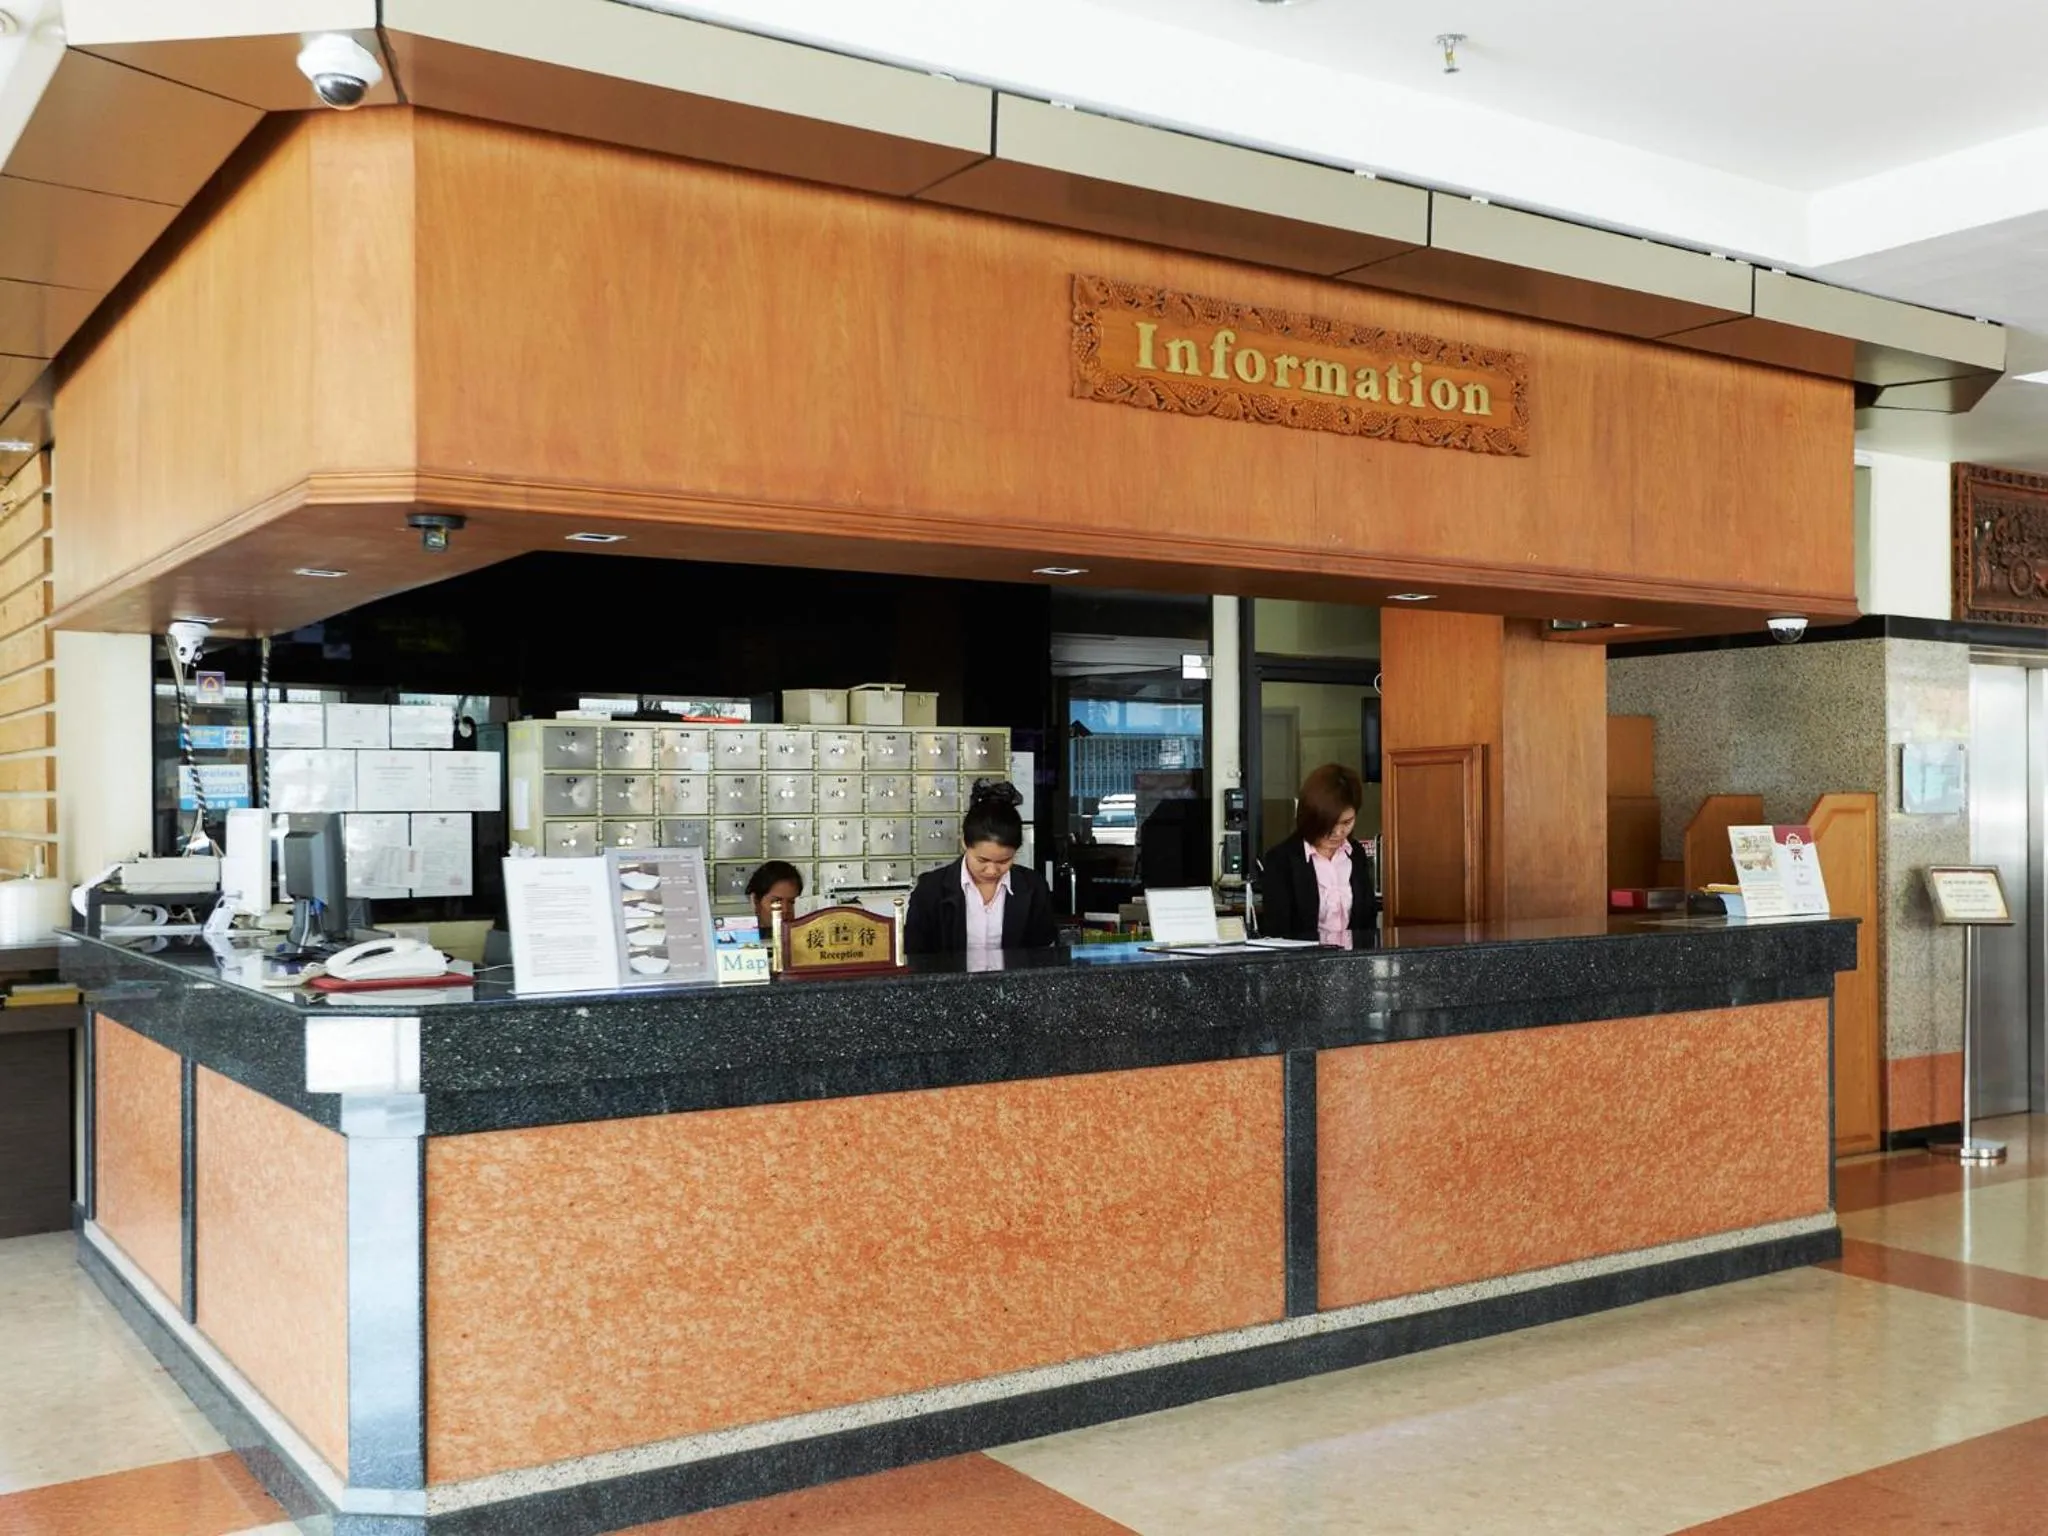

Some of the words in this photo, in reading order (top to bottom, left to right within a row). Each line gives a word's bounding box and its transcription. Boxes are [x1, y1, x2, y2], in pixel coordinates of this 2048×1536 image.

[1135, 320, 1493, 417] Information
[723, 955, 767, 974] Map
[819, 950, 864, 961] Reception
